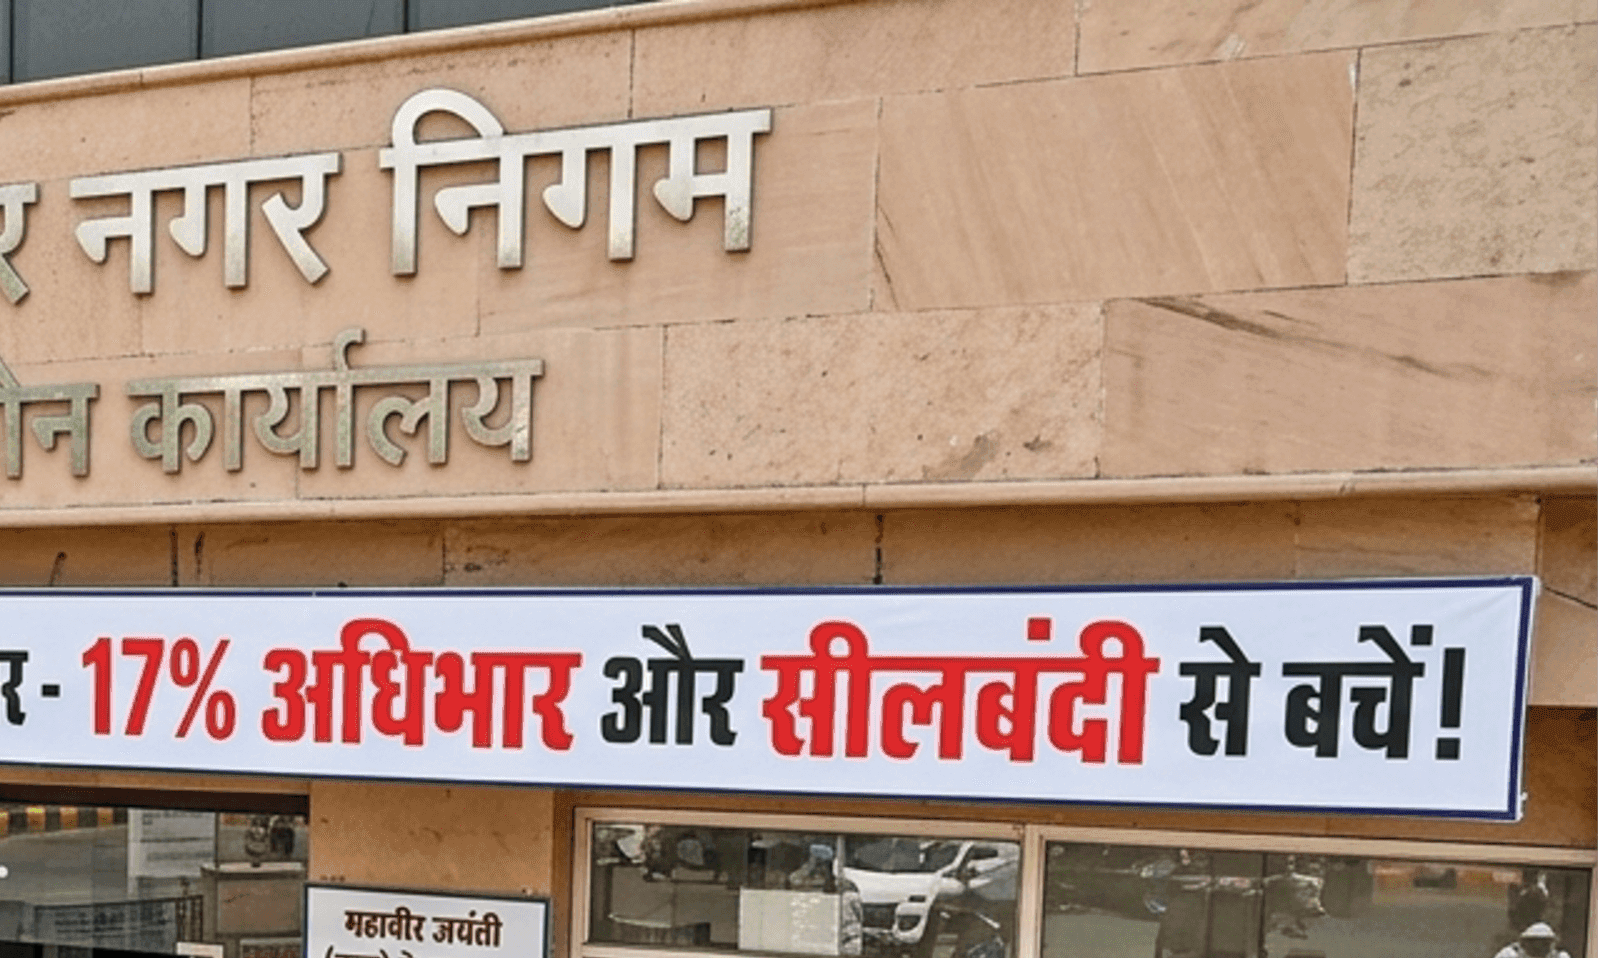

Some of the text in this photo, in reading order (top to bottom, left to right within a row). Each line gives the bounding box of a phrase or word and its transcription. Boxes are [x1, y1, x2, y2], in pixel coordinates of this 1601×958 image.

[69, 152, 342, 295] नगर
[379, 87, 773, 277] निगम
[127, 328, 545, 475] कार्यालय
[82, 636, 236, 742] 17%
[261, 617, 583, 751] अधिभार
[601, 624, 745, 746] और
[760, 617, 1161, 765] सीलबंदी
[1179, 626, 1262, 757] से
[344, 906, 426, 942] महावीर
